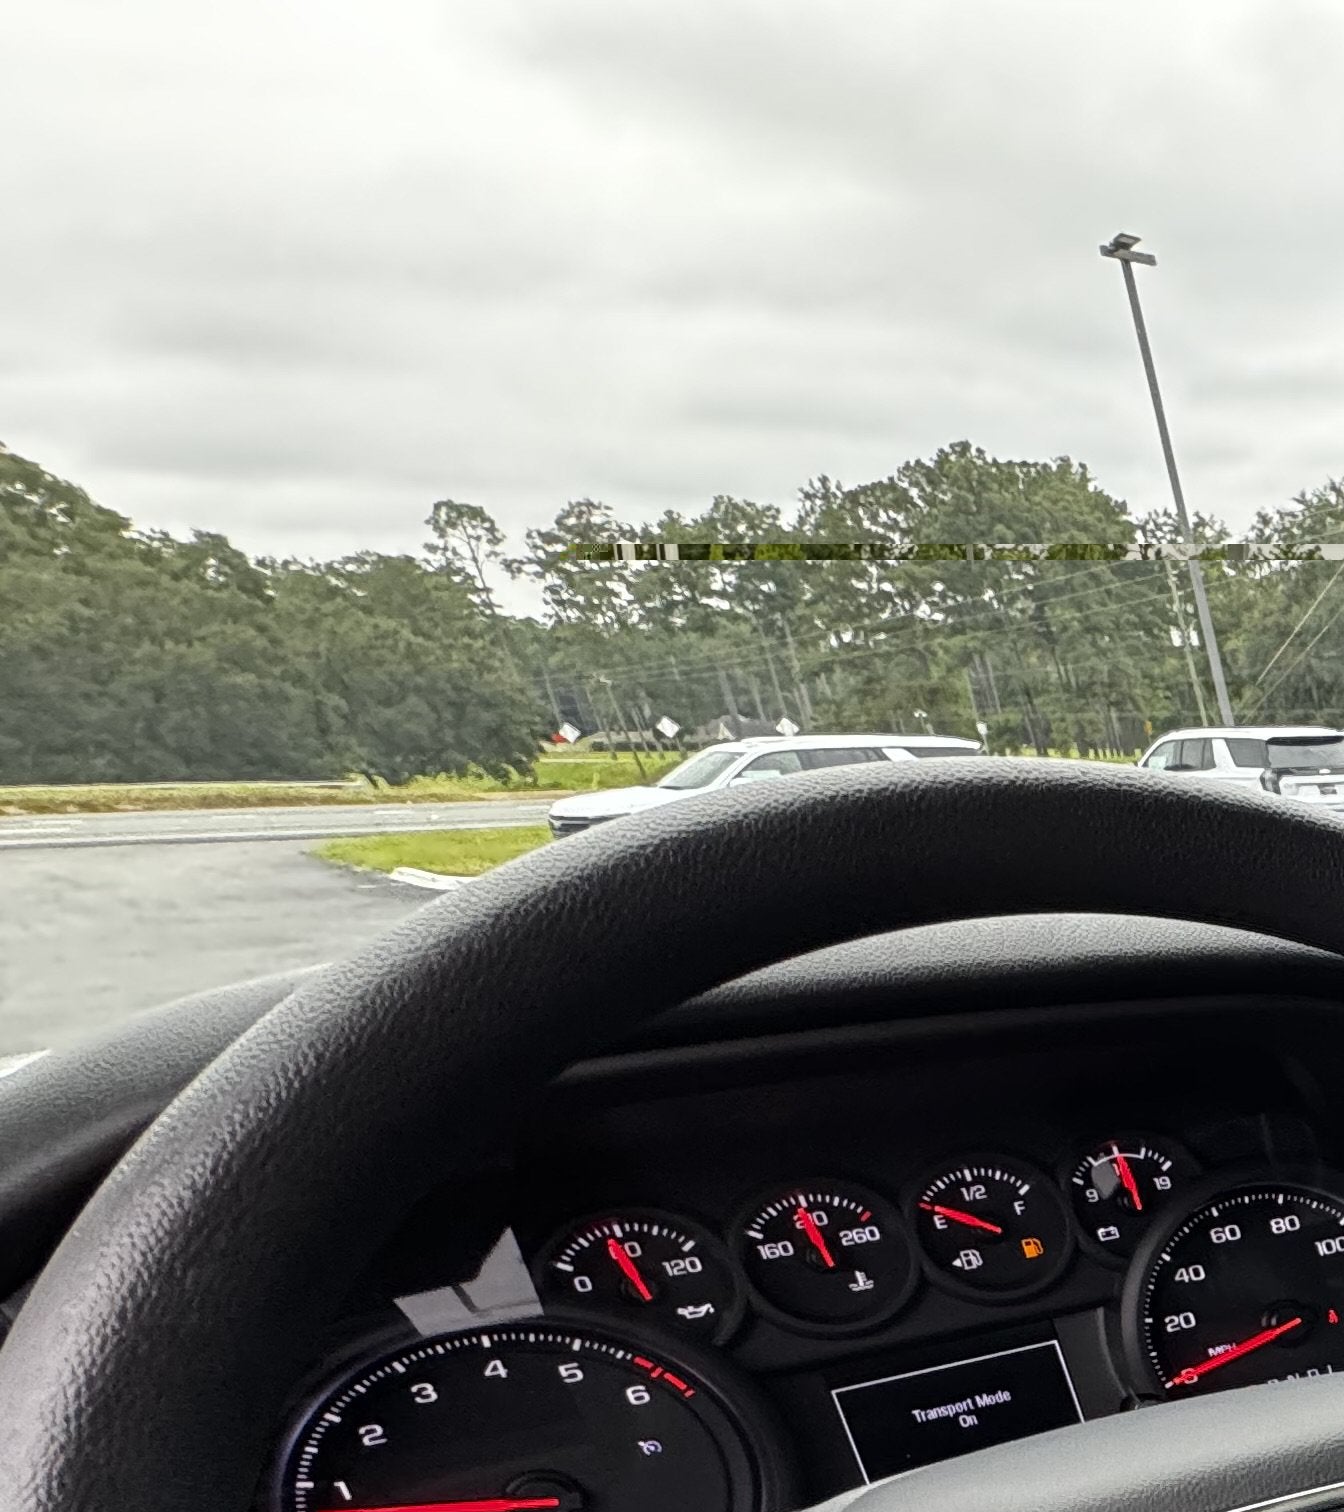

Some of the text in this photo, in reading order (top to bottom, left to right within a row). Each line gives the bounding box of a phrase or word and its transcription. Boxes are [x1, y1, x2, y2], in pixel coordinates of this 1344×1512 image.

[959, 1184, 988, 1201] 1/2
[1085, 1175, 1172, 1203] 9 19
[1014, 1200, 1026, 1216] F
[1209, 1224, 1242, 1244] 60
[1269, 1215, 1301, 1235] 80
[756, 1225, 881, 1261] 160 260
[573, 1256, 703, 1292] 0 120
[1174, 1264, 1206, 1284] 40
[1164, 1312, 1196, 1333] 20
[483, 1359, 508, 1379] 4
[409, 1362, 584, 1404] 3 5
[358, 1385, 651, 1447] 2 6
[911, 1389, 1012, 1424] Transport Mode
[958, 1414, 979, 1429] On
[333, 1480, 353, 1500] 1
